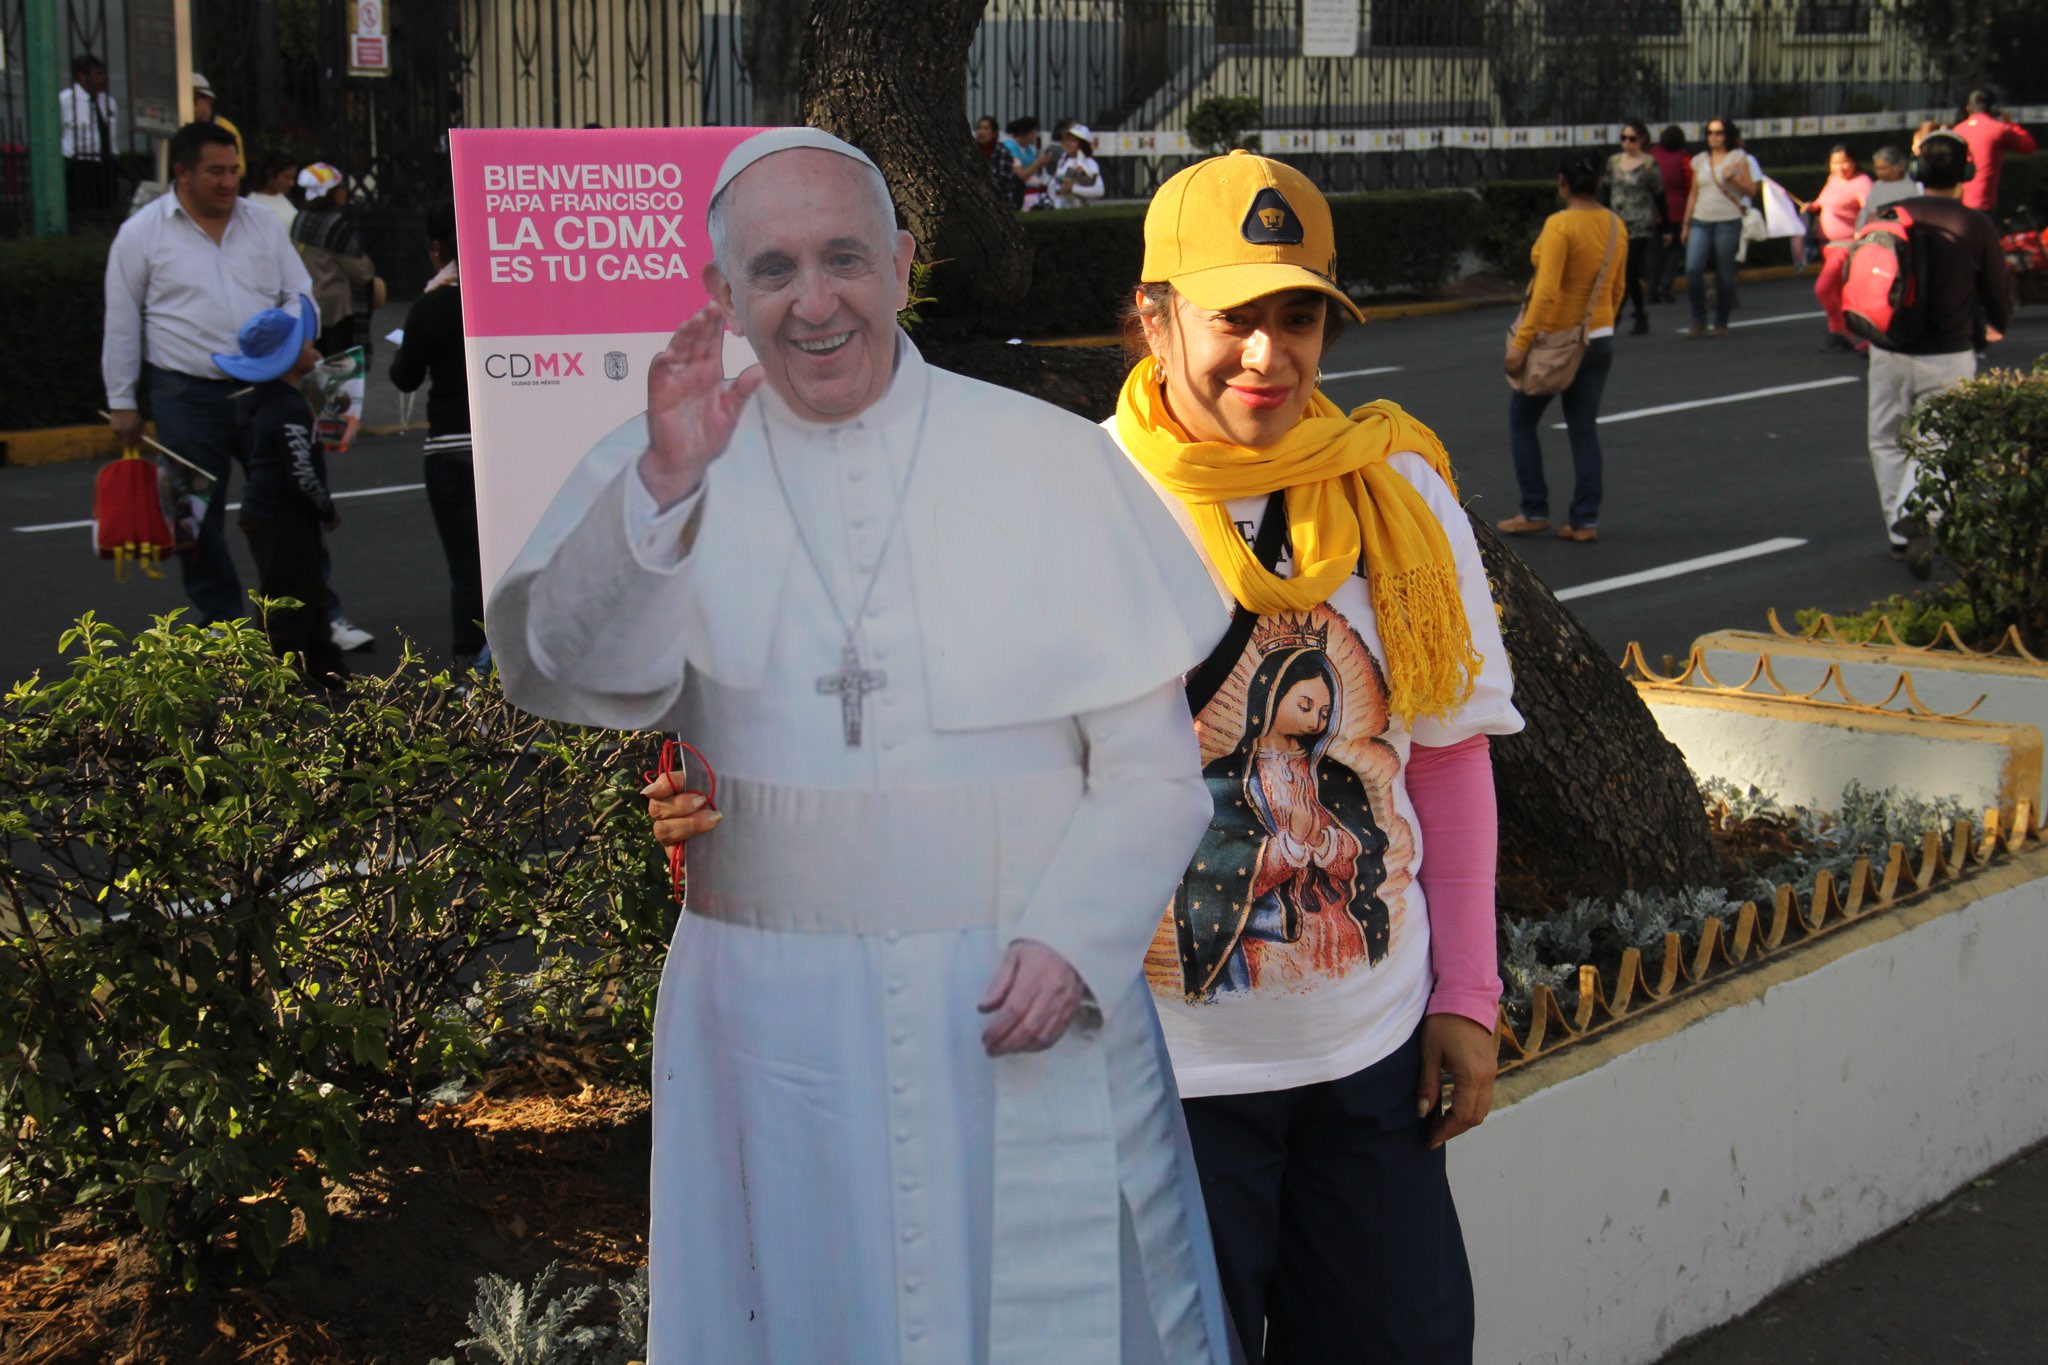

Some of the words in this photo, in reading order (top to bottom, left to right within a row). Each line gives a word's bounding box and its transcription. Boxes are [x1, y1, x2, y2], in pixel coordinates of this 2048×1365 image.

[484, 163, 682, 191] BIENVENIDO
[486, 194, 545, 212] PAPA
[550, 192, 684, 212] FRANCISCO
[487, 216, 544, 251] LA
[554, 215, 687, 250] CDMX
[490, 256, 534, 283] ES
[541, 255, 587, 282] TU
[596, 253, 689, 281] CASA
[485, 352, 585, 379] CDMX
